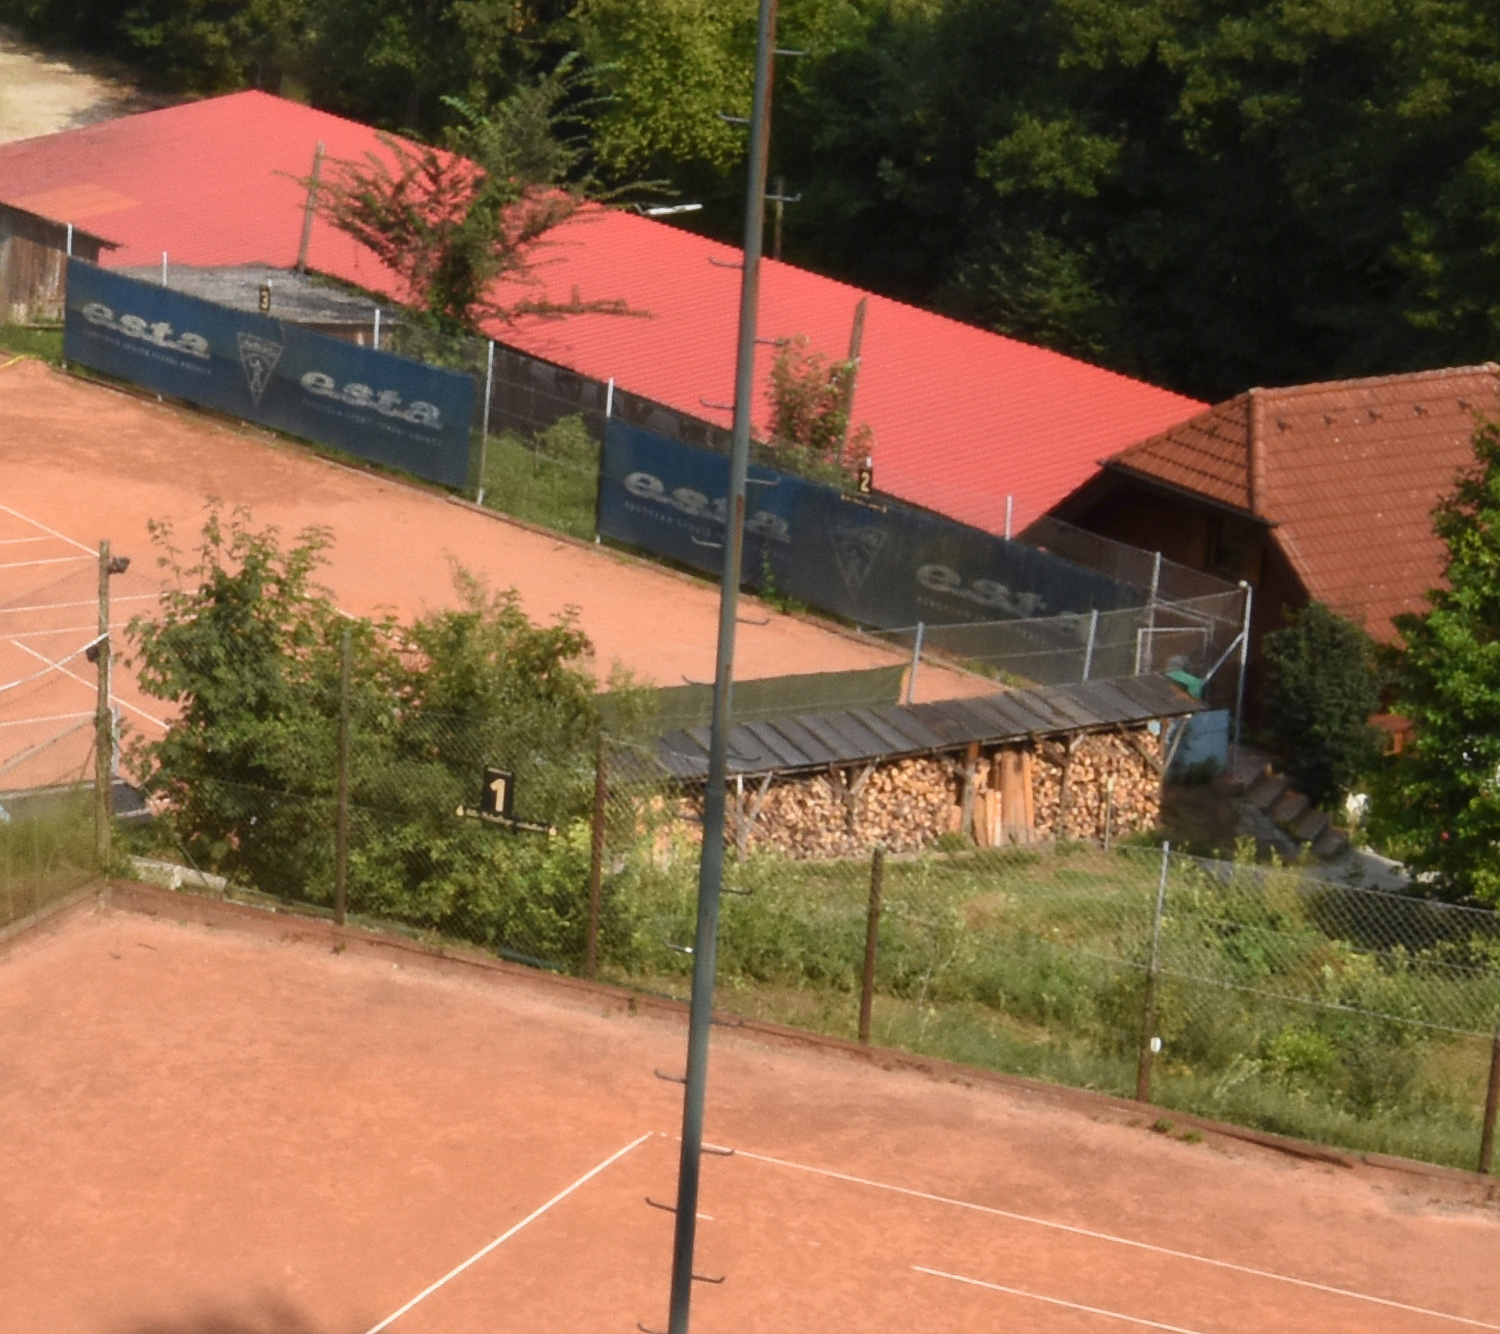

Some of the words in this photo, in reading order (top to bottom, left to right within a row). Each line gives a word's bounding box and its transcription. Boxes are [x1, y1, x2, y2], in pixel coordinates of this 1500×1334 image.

[261, 291, 269, 309] 3
[83, 302, 211, 359] esta
[301, 371, 443, 431] esta
[860, 471, 871, 493] 2
[490, 778, 506, 812] 1
